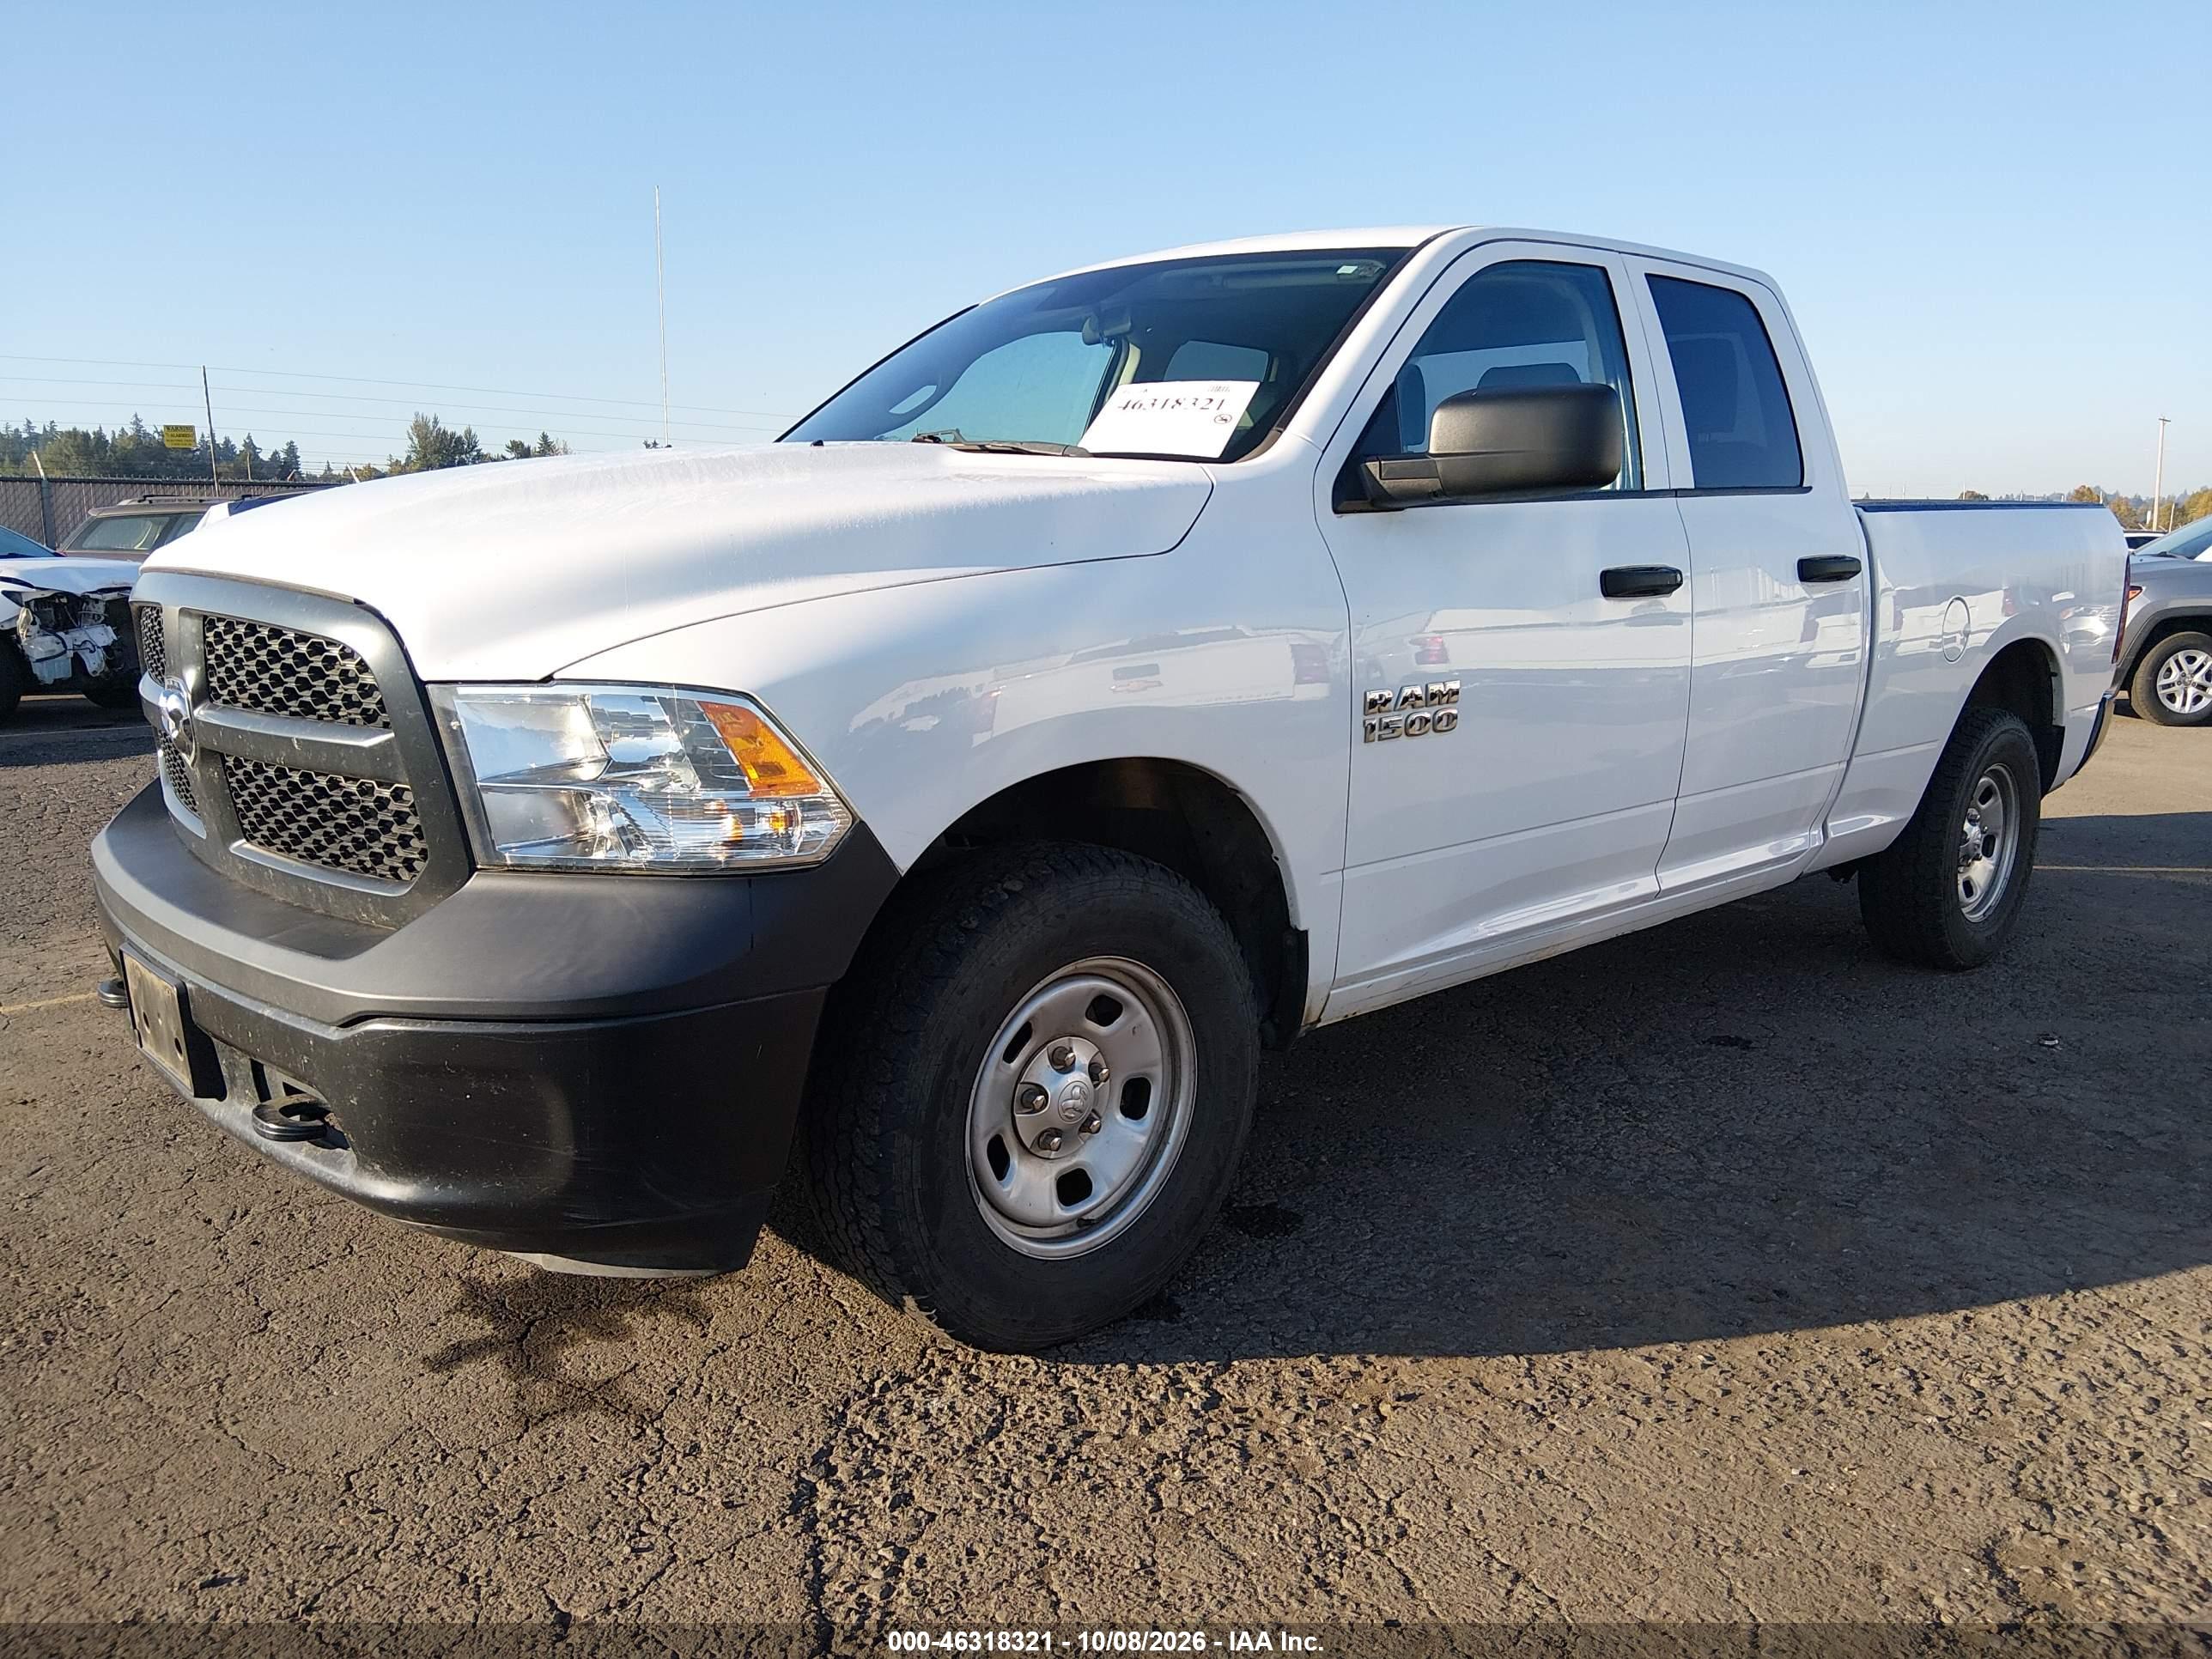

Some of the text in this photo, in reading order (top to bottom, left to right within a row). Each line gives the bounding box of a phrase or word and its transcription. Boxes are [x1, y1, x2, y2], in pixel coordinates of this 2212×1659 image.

[1118, 398, 1225, 410] 46318321
[1364, 679, 1461, 716] RAM
[1363, 707, 1459, 744] 1500
